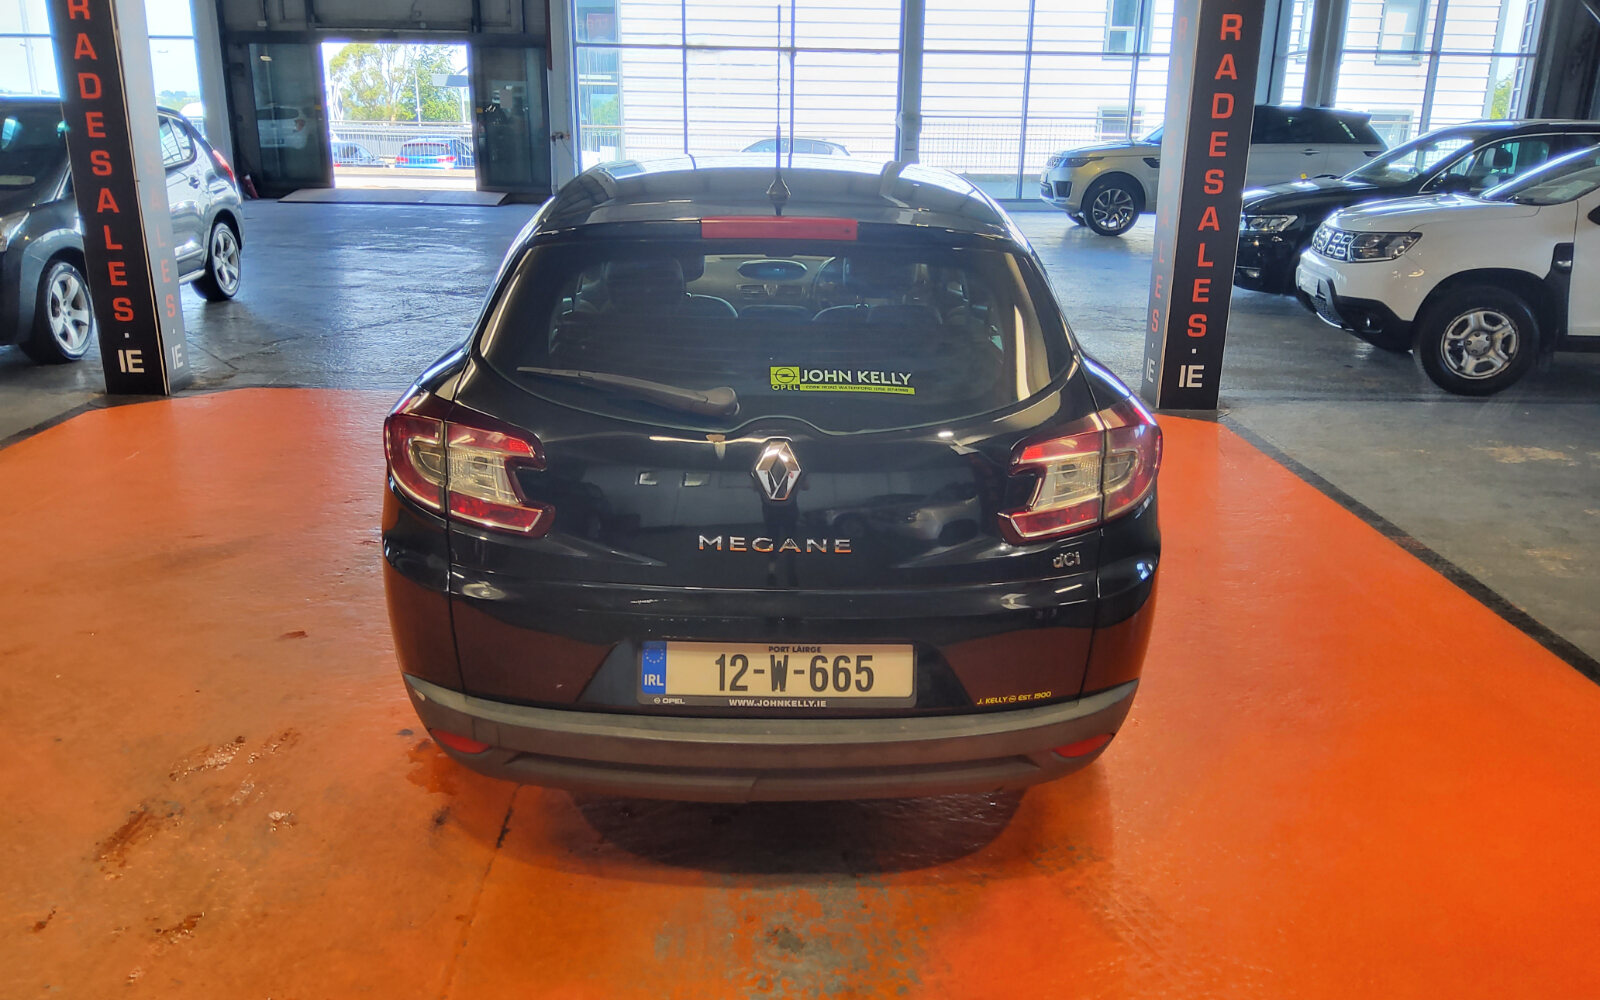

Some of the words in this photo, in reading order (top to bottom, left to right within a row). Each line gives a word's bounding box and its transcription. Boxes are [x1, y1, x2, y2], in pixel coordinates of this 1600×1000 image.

[1178, 0, 1243, 389] RADESALES.IE
[800, 369, 852, 383] JOHN
[857, 370, 912, 386] KELLY
[698, 535, 852, 553] MEGANE
[1052, 551, 1081, 568] dCi
[768, 645, 790, 653] PORT
[644, 674, 664, 687] IRL
[714, 653, 875, 693] 12-W-665
[662, 697, 686, 705] OPEL
[728, 698, 827, 708] WWW.JOHNKELLY.IE
[985, 696, 1008, 705] KELLY
